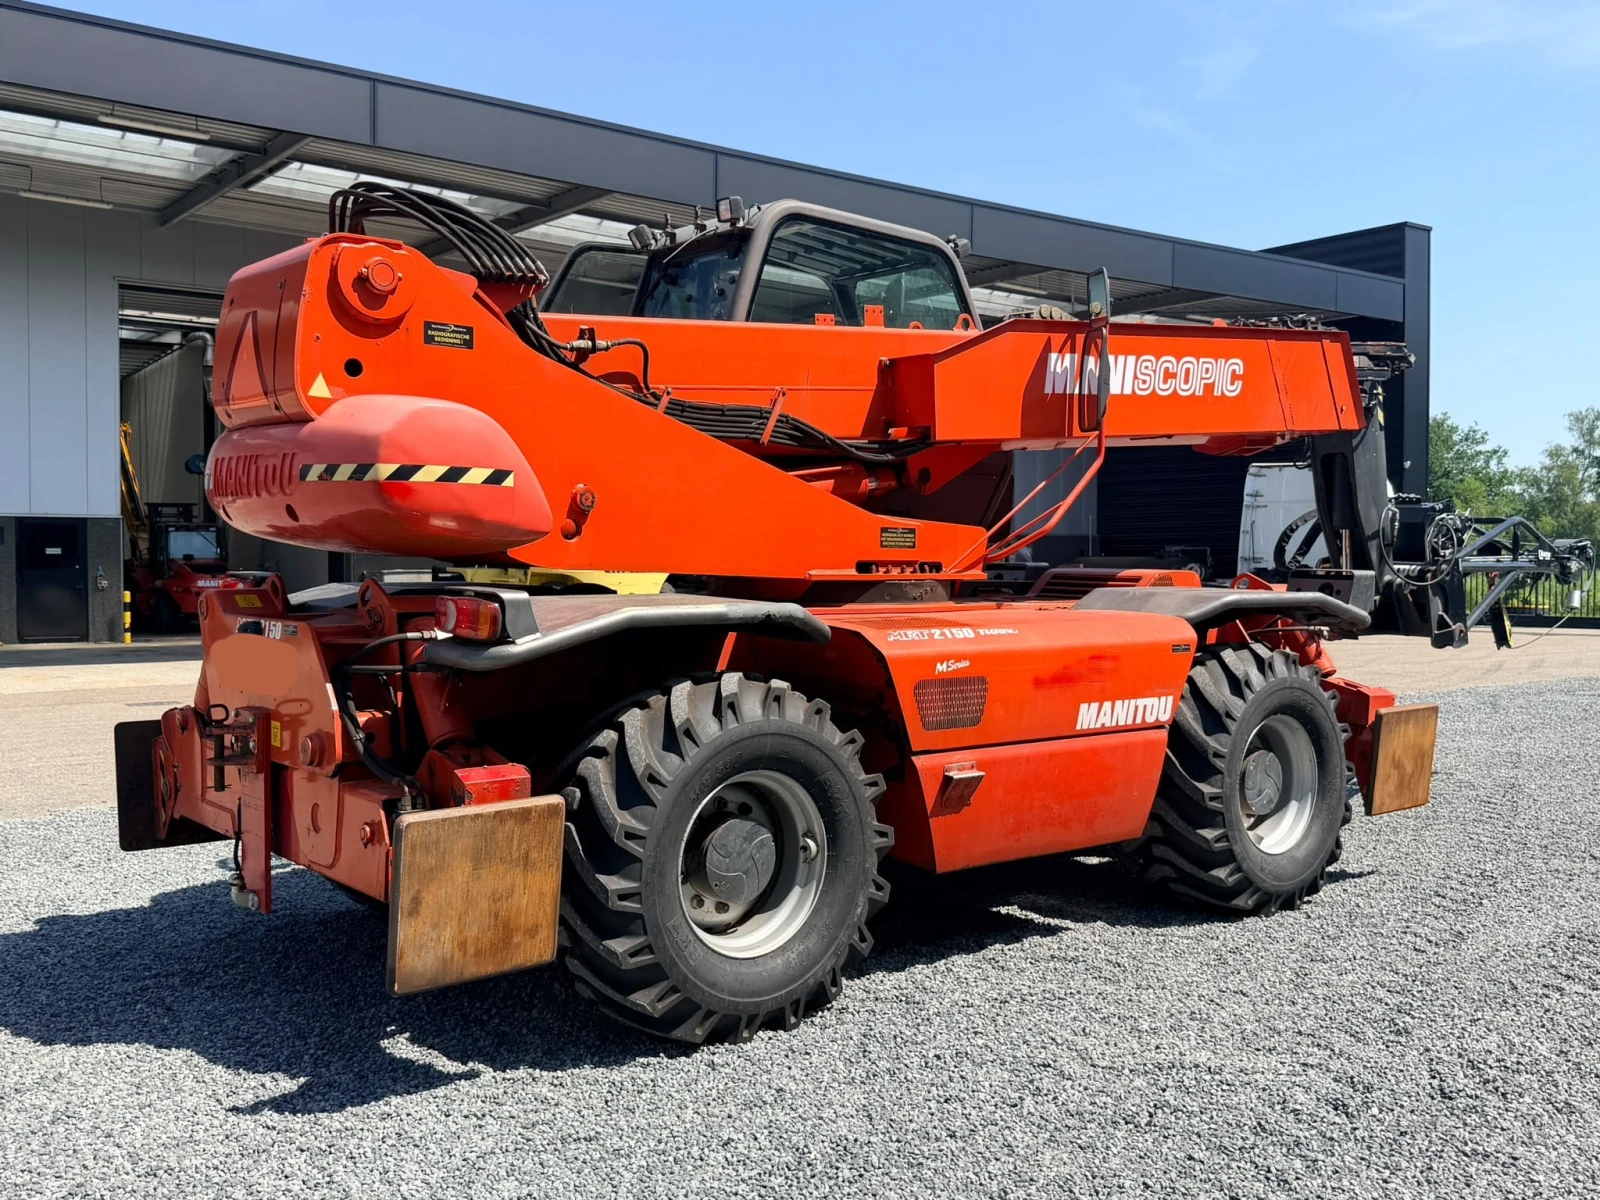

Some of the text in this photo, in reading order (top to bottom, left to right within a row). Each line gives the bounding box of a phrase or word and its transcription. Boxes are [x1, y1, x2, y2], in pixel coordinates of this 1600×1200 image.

[428, 330, 470, 340] RADIOGRAFISCHE
[1044, 353, 1244, 397] MANISCOPIC
[214, 452, 298, 497] MANITOU
[887, 629, 930, 642] MRT
[930, 627, 975, 640] 2150
[1075, 695, 1174, 730] MANITOU
